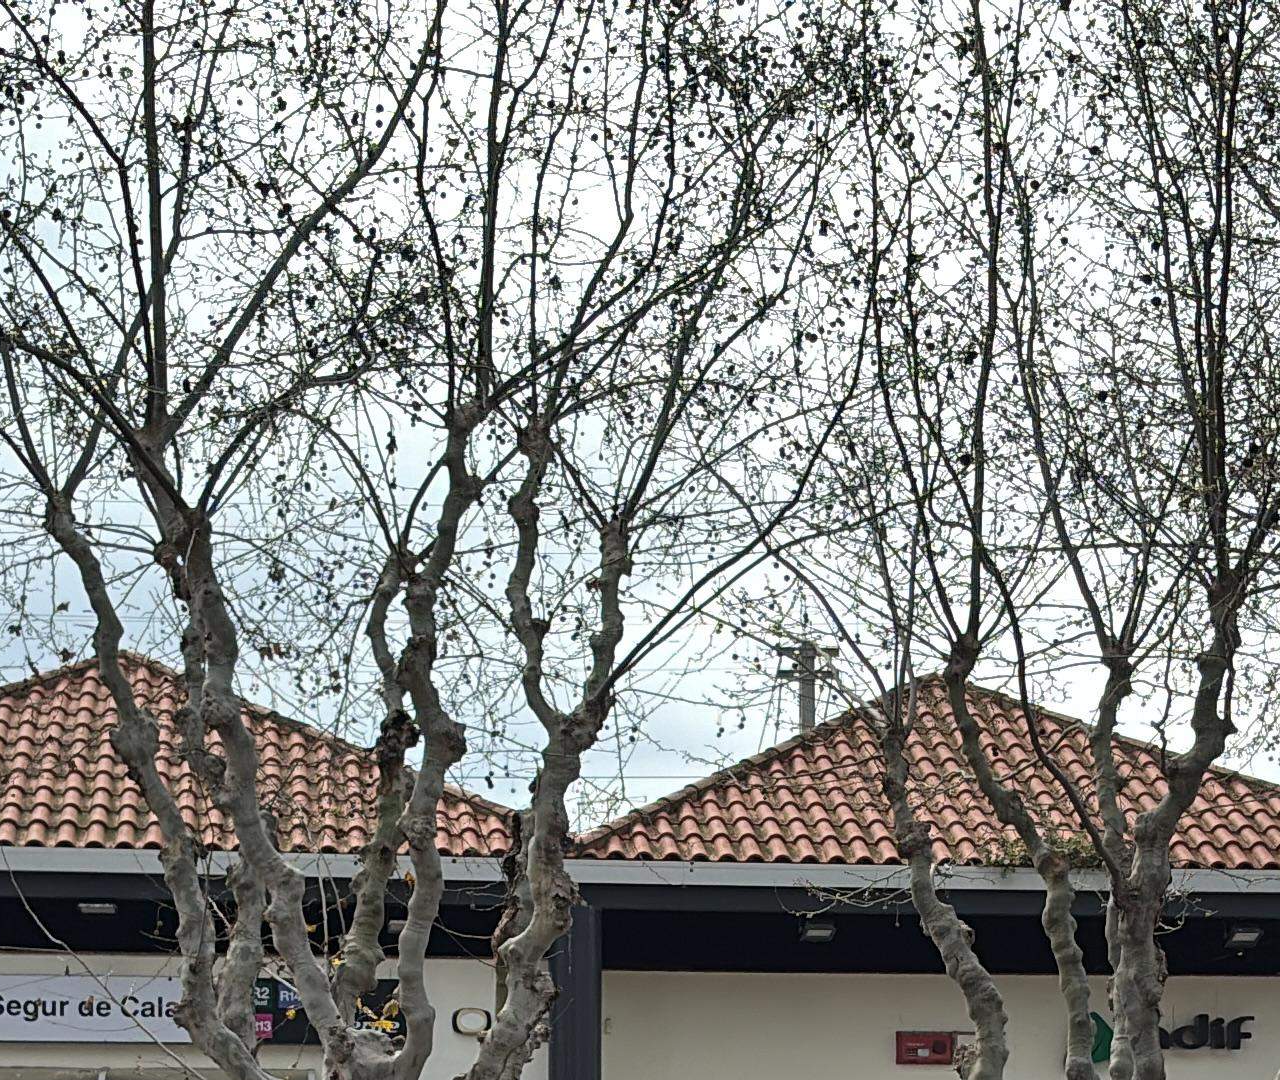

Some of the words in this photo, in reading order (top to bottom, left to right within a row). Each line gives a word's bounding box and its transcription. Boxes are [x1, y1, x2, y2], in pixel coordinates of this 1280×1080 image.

[78, 995, 112, 1017] de
[120, 994, 179, 1018] Cala
[1158, 1013, 1256, 1050] dif
